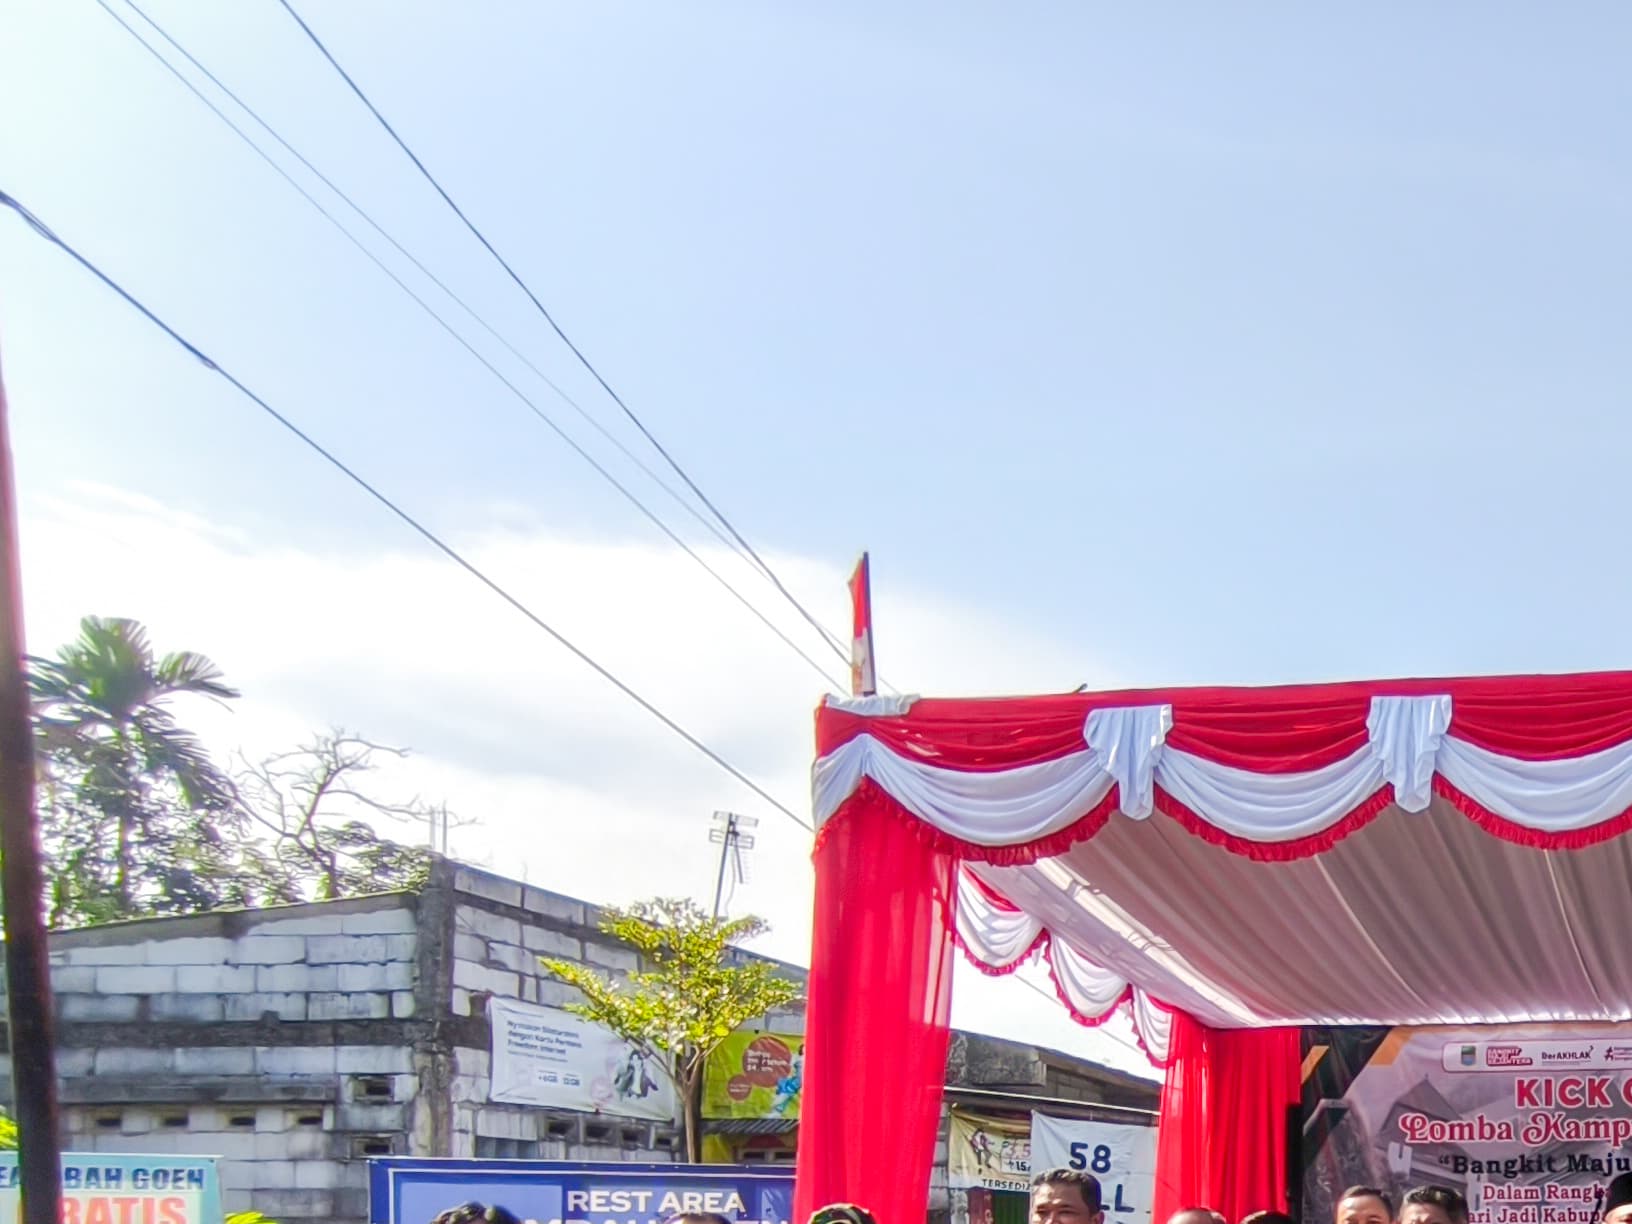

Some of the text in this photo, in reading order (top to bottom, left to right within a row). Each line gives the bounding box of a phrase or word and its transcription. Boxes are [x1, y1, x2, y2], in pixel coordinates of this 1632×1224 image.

[1517, 1077, 1611, 1107] KICK
[1400, 1114, 1513, 1142] Lomba
[1068, 1141, 1112, 1174] 58
[1567, 1152, 1631, 1176] Maju
[65, 1166, 205, 1190] BAH GOEN
[567, 1190, 746, 1213] REST AREA
[1483, 1184, 1540, 1200] Dalam
[1468, 1208, 1492, 1223] ari
[1497, 1207, 1537, 1223] Jadi
